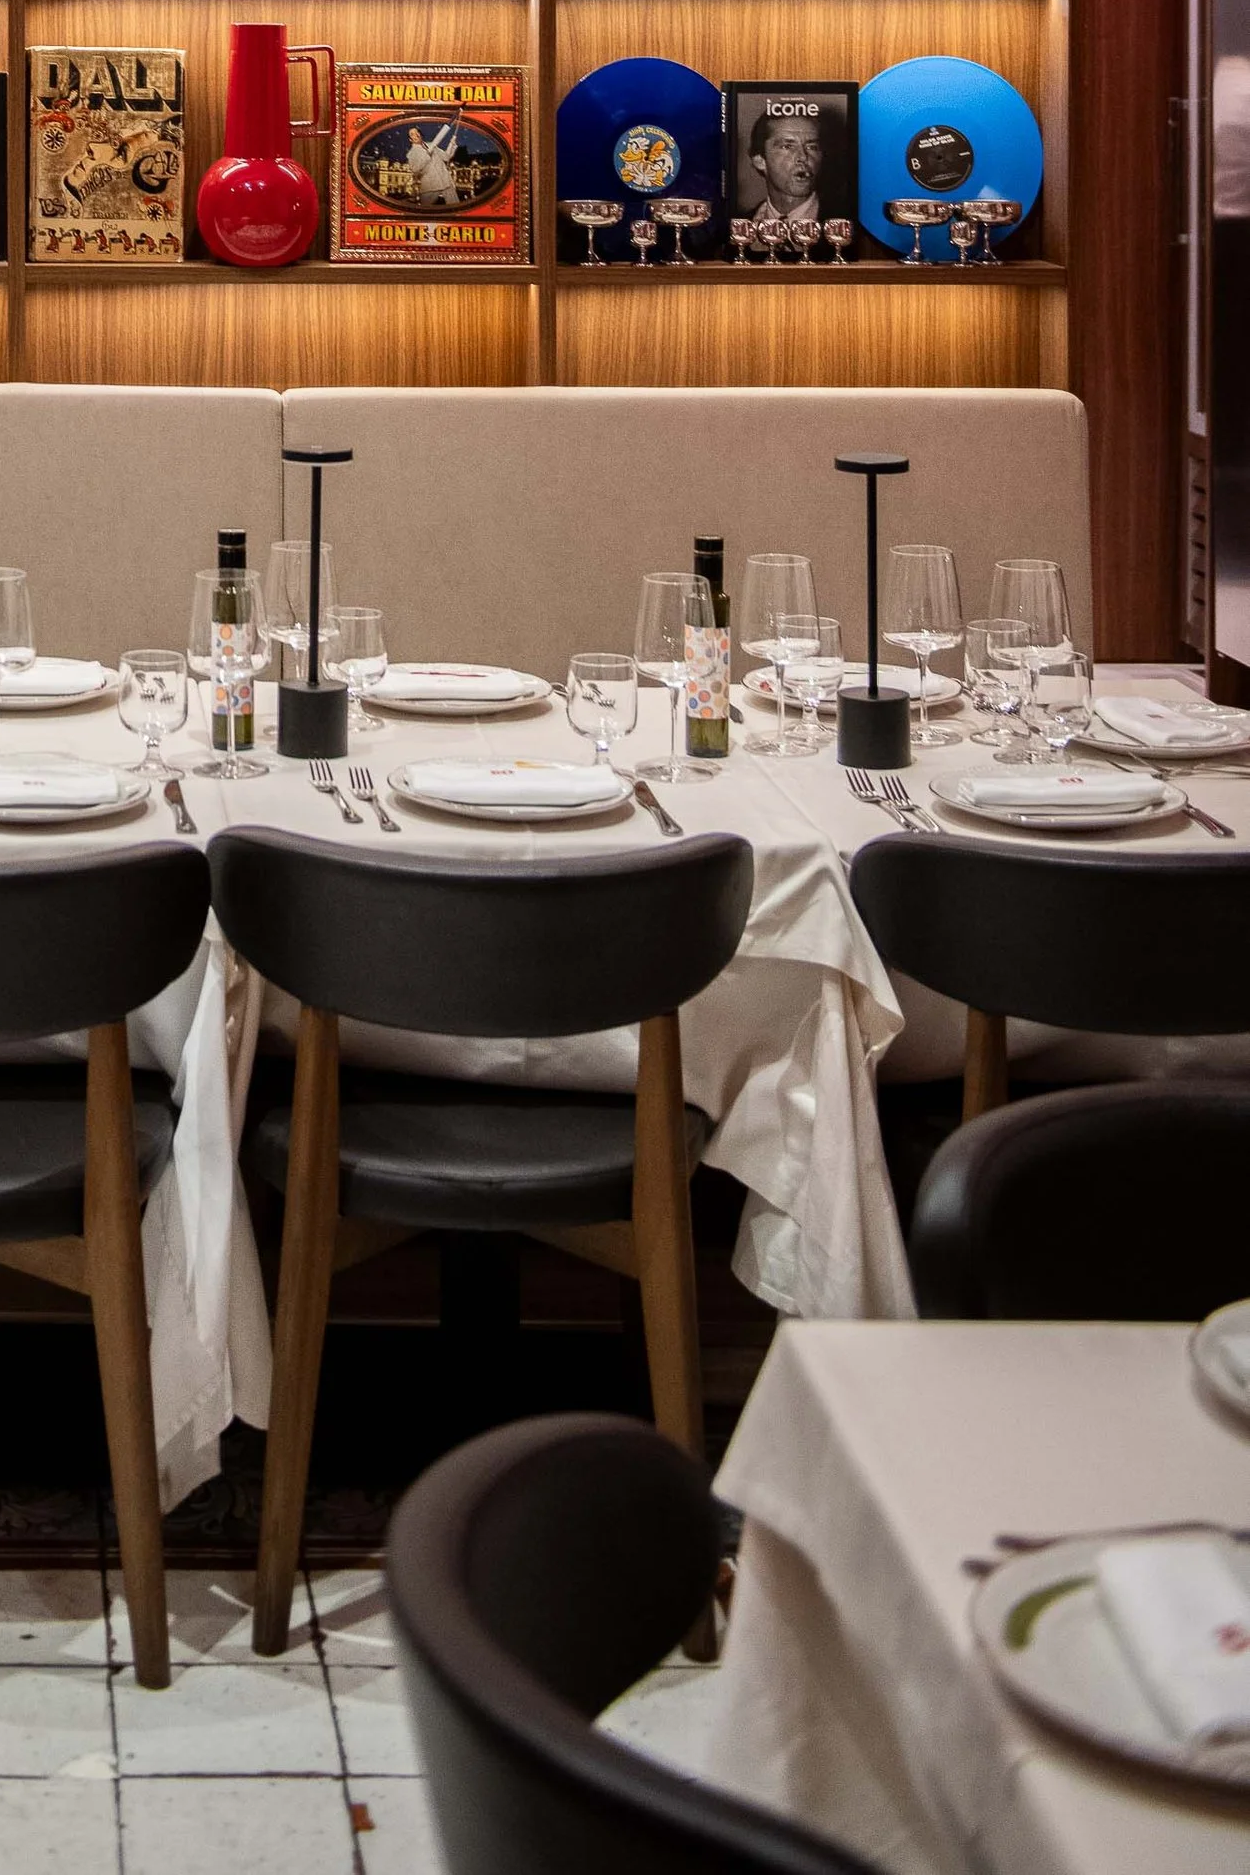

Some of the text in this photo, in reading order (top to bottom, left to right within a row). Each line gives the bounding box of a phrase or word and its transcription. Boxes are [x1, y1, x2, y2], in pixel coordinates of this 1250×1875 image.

[37, 54, 183, 111] DALI
[360, 84, 502, 102] SALVADOR DALI
[766, 99, 820, 116] icone
[911, 158, 921, 170] B
[364, 224, 496, 243] MONTE-CARLO
